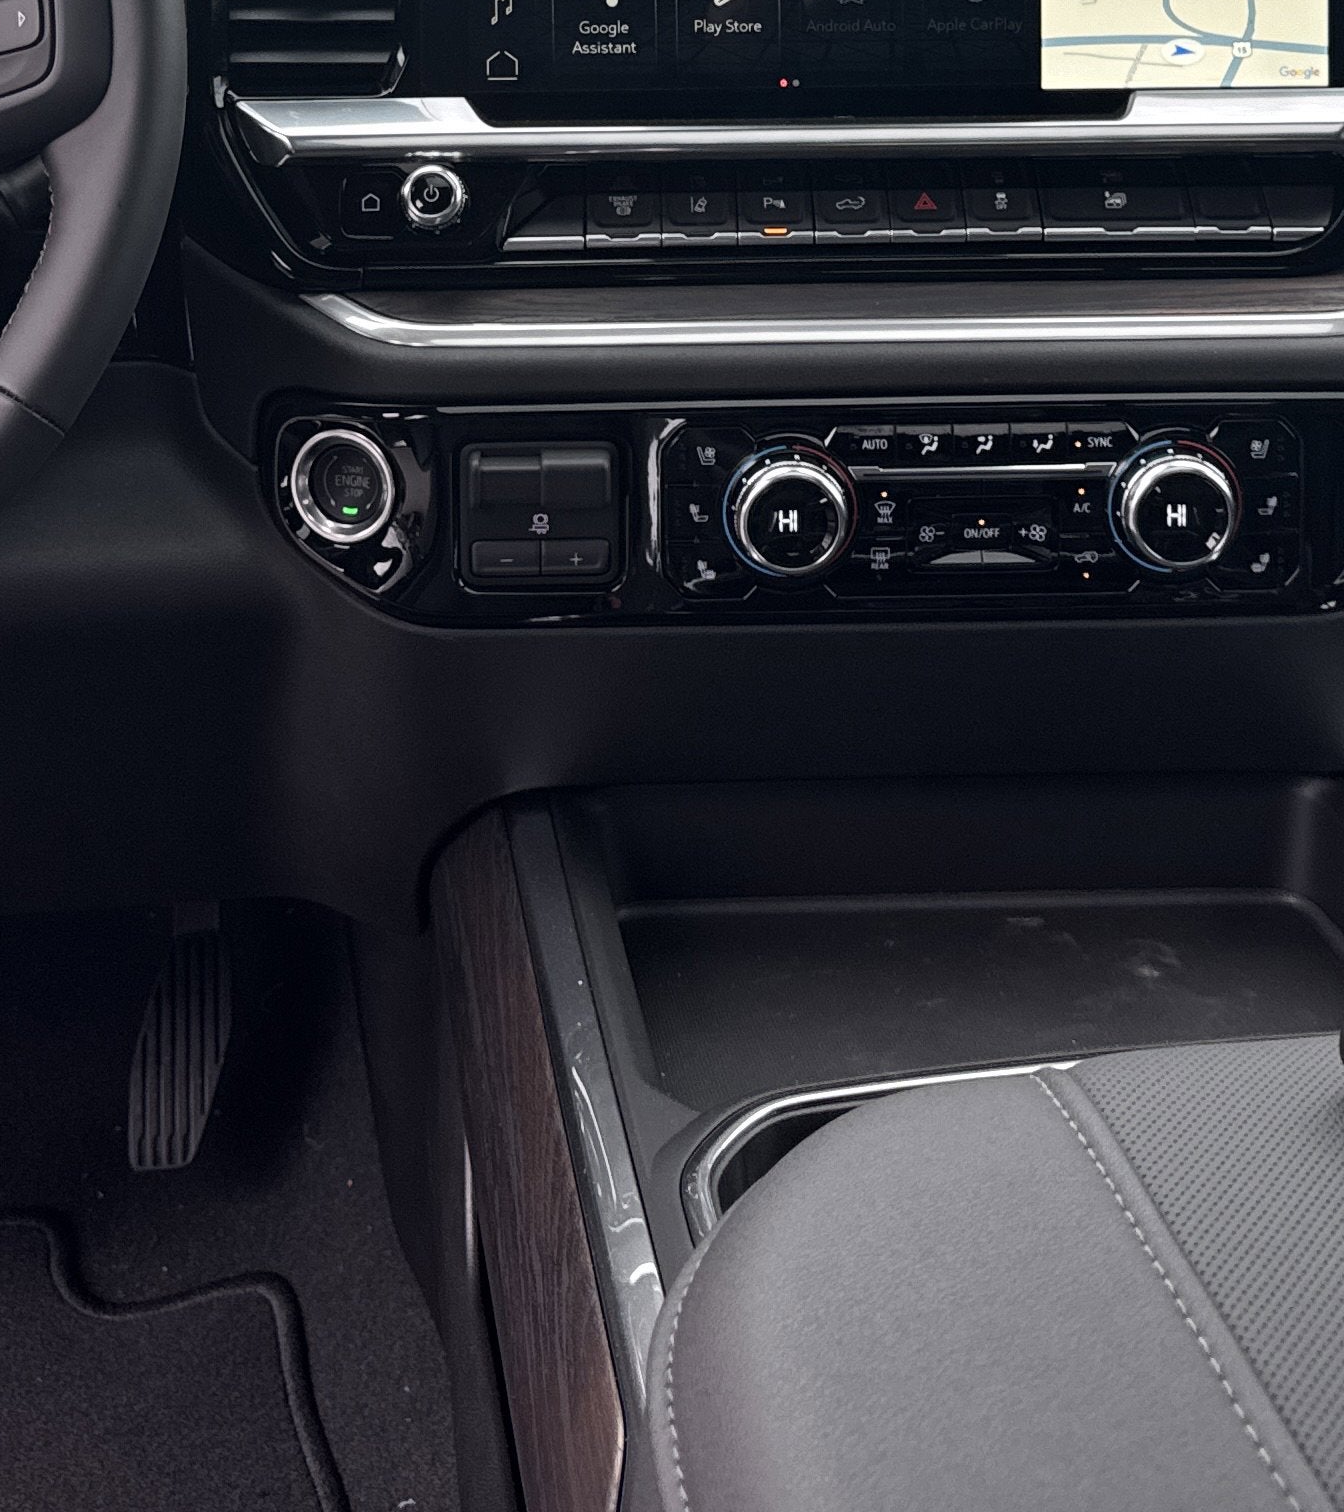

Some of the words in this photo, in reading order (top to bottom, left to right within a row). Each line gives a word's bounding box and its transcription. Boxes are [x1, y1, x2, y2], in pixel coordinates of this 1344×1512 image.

[579, 20, 629, 37] Google
[694, 19, 722, 36] Play
[726, 19, 762, 33] Store
[806, 19, 859, 33] Android
[863, 19, 896, 32] Auto
[927, 18, 966, 33] Apple
[970, 18, 1023, 33] CarPlay
[572, 41, 637, 55] Assistant
[1279, 65, 1320, 80] Google
[862, 439, 888, 450] AUTO
[1087, 437, 1113, 448] SYNC
[336, 474, 371, 489] ENGINE
[344, 488, 364, 498] STOP
[1073, 502, 1091, 513] A/C
[1166, 503, 1187, 527] HI
[963, 527, 1000, 539] ON/OFF
